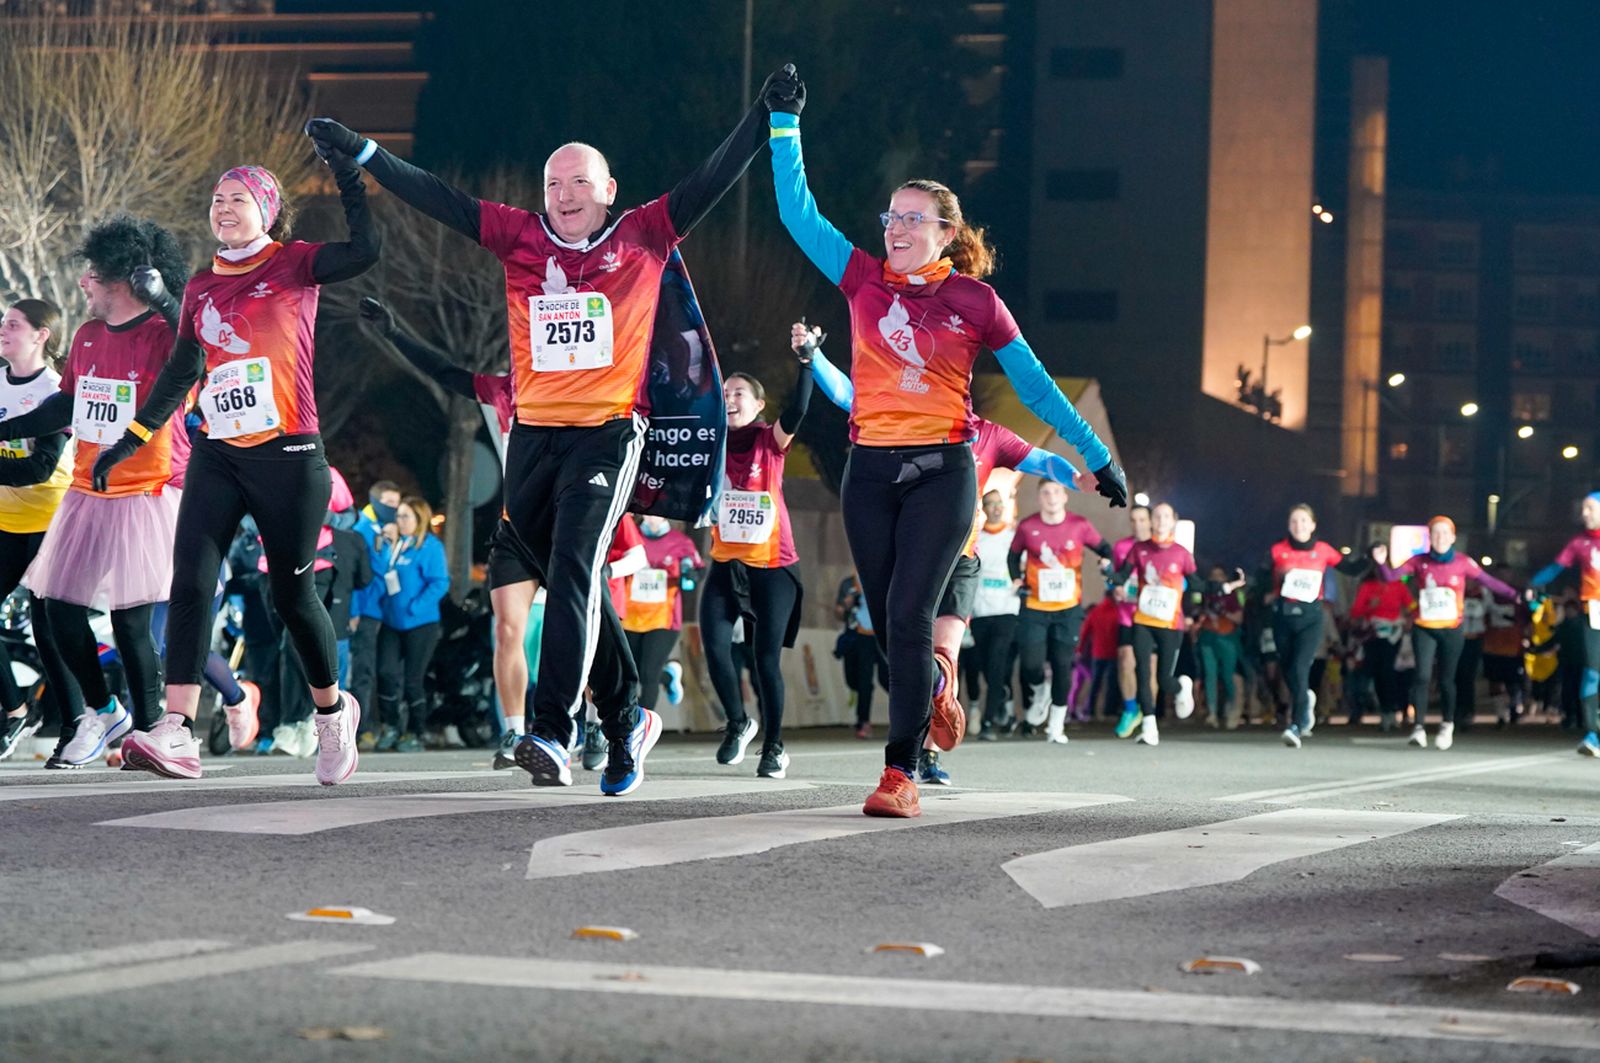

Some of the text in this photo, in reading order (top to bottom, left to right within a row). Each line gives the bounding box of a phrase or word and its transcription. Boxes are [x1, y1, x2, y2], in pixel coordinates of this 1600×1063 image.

[546, 302, 580, 311] NOCHE DE
[538, 313, 552, 321] SAN
[546, 320, 595, 345] 2573
[889, 329, 912, 351] 43
[212, 385, 257, 413] 1368
[87, 401, 118, 422] 7170
[655, 450, 710, 467] hacer
[639, 471, 665, 489] res
[729, 508, 764, 526] 2955
